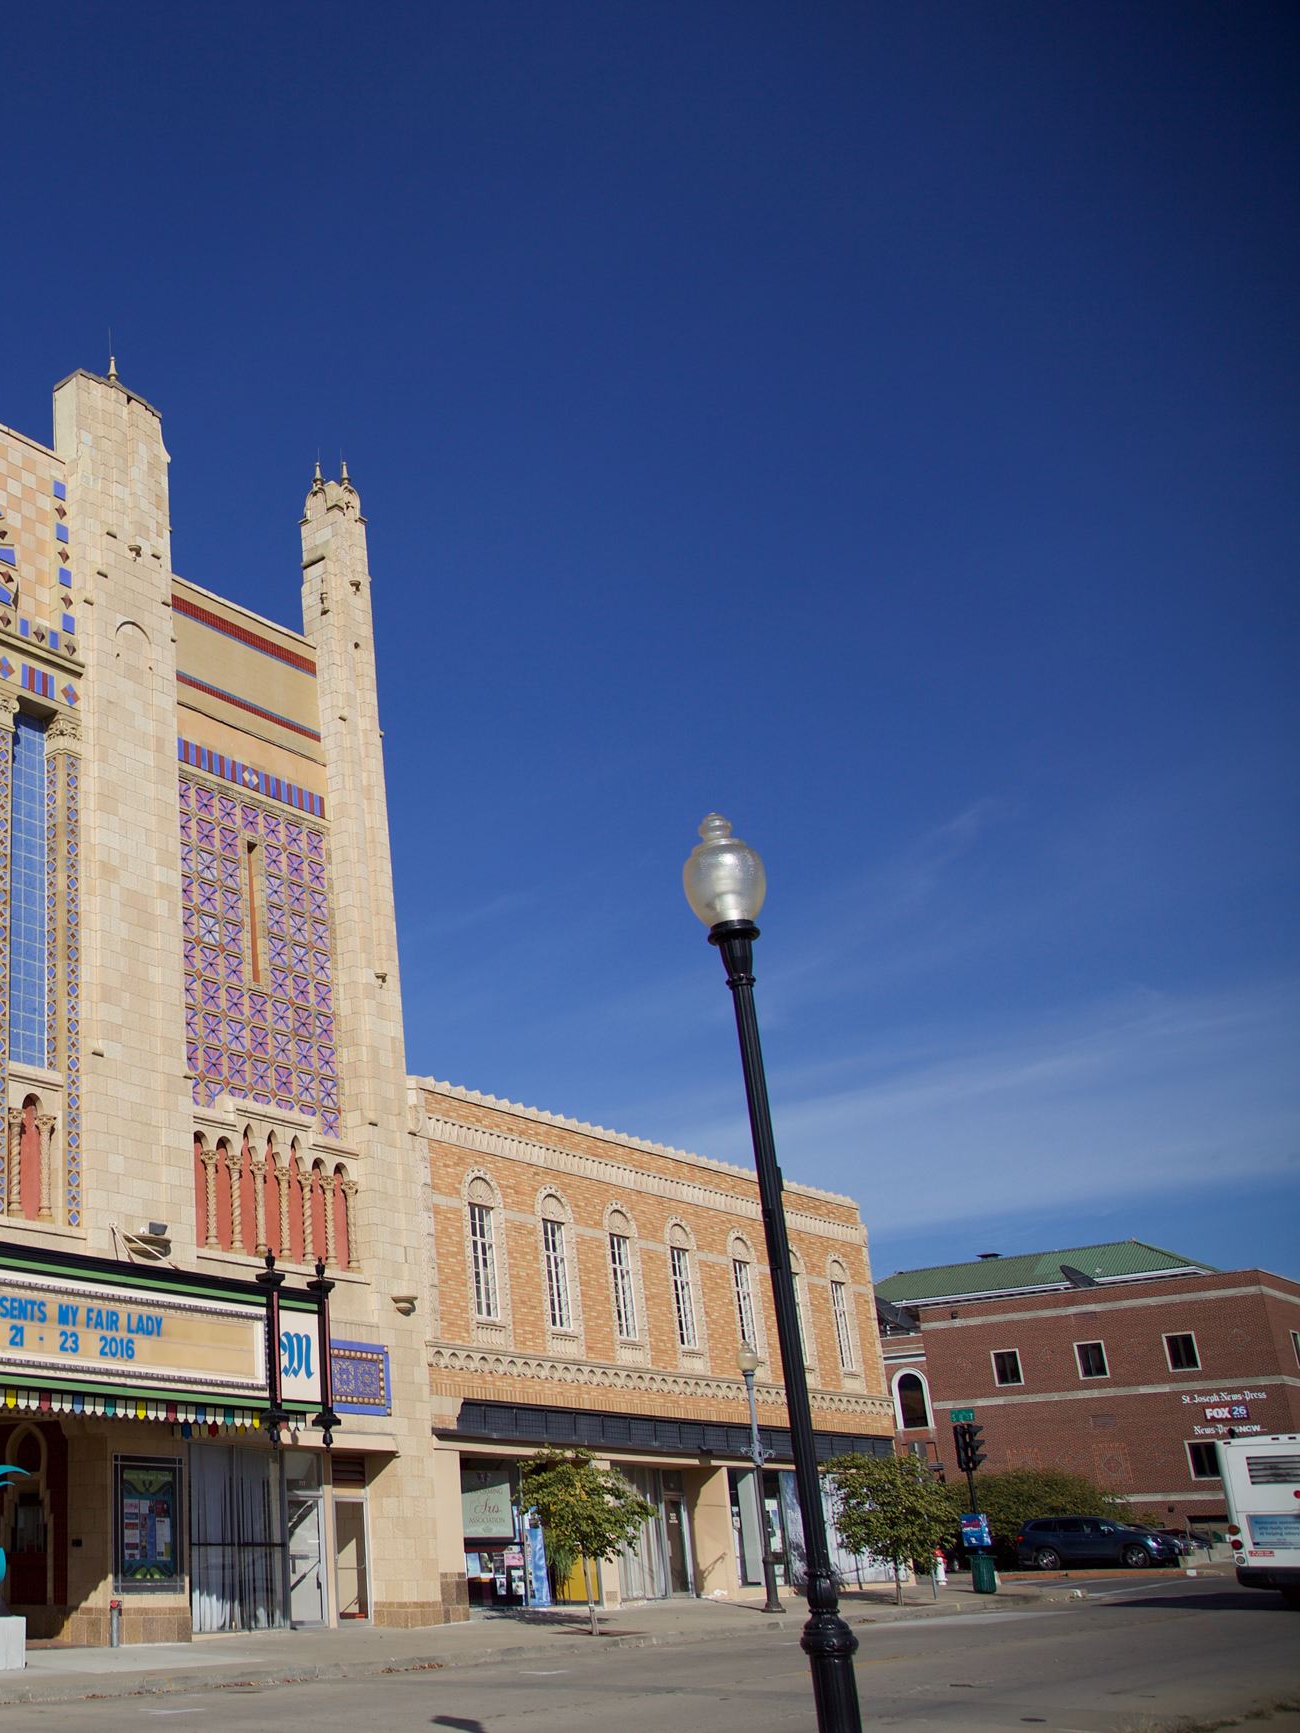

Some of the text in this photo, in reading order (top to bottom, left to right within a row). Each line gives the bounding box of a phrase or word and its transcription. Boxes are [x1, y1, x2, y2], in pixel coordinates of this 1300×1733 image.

[57, 1303, 79, 1327] MY
[86, 1307, 119, 1332] FAIR
[127, 1313, 163, 1338] LADY
[9, 1324, 25, 1347] 21
[59, 1331, 79, 1353] 23
[99, 1336, 135, 1360] 2016
[279, 1331, 314, 1380] M
[1194, 1393, 1219, 1403] Joseph
[1205, 1405, 1247, 1419] FOX 26
